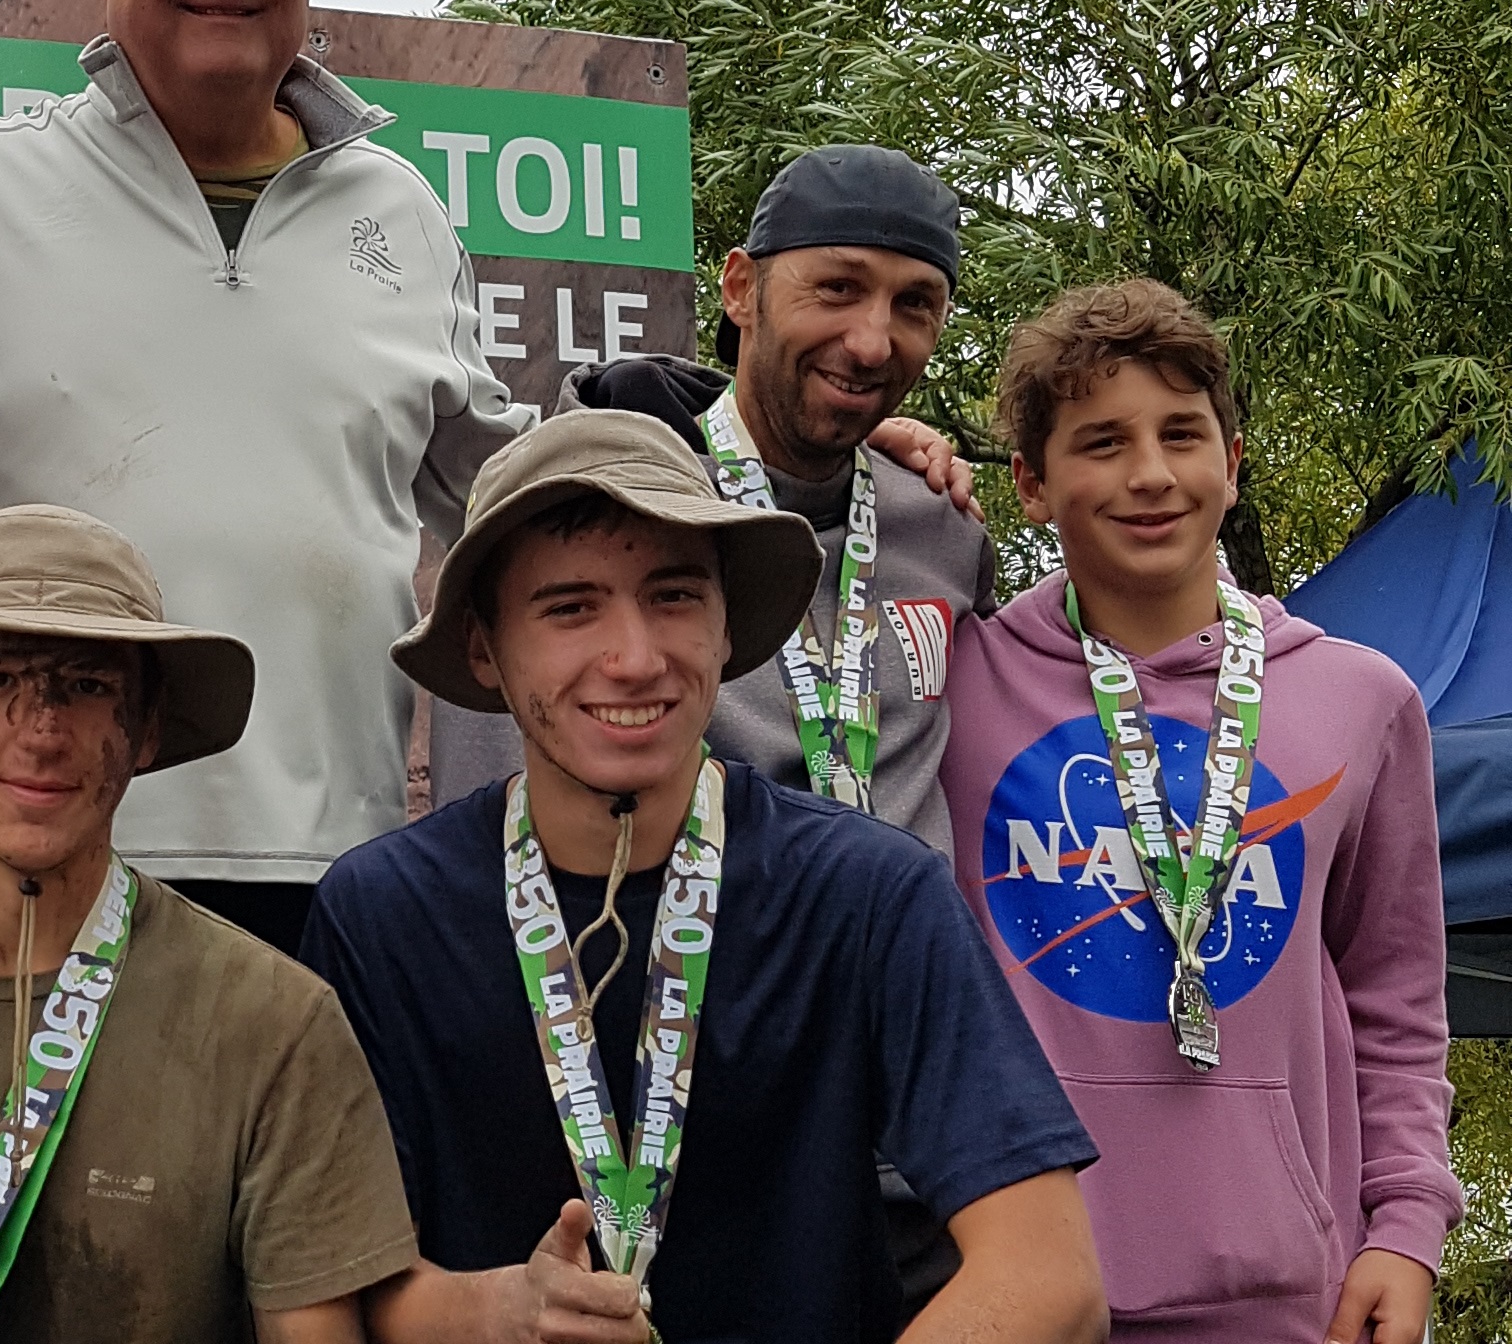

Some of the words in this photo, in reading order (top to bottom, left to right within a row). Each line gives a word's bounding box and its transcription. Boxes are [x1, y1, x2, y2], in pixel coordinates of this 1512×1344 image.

[422, 130, 642, 241] TOI!
[349, 259, 364, 273] La
[367, 267, 402, 294] Prairie
[478, 282, 527, 359] E
[557, 287, 648, 364] LE
[706, 397, 741, 453] DÉFI
[845, 470, 878, 565] 350
[847, 577, 867, 612] LA
[838, 615, 867, 723] PRAIRIE
[885, 606, 923, 697] BURTON
[1219, 619, 1265, 704] 350
[1112, 711, 1143, 745] LA
[1216, 715, 1245, 749] LA
[1120, 748, 1171, 858] PRAIRIE
[1199, 750, 1238, 861] PRAIRIE
[505, 838, 566, 954] 350
[661, 837, 722, 954] 350
[29, 952, 115, 1071] 350
[539, 972, 574, 1019] LA
[659, 977, 689, 1021] LA
[551, 1020, 612, 1160] PRAIRIE
[639, 1027, 684, 1169] PRAIRIE
